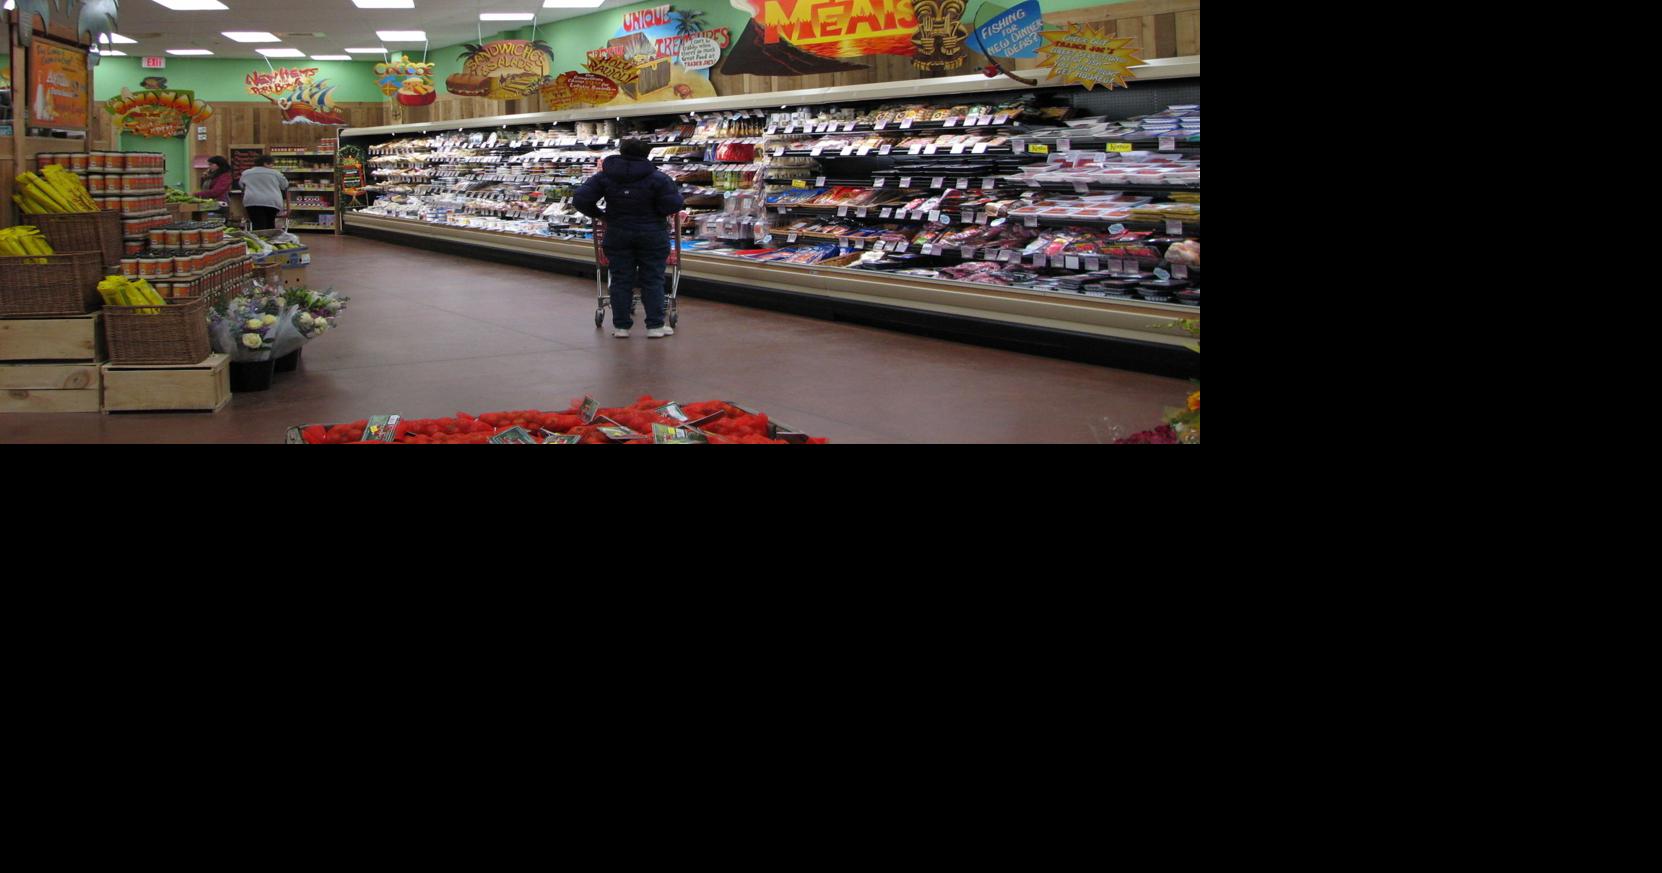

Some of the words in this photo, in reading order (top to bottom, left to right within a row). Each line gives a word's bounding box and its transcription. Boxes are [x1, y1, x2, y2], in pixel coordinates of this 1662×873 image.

[623, 4, 672, 32] UNIQUE
[981, 8, 1026, 39] FISHING
[1002, 25, 1019, 37] FOR
[655, 26, 731, 59] TRERES
[987, 38, 1010, 57] NEW
[1011, 20, 1043, 42] DINNER
[1004, 31, 1041, 58] IDEAS?
[1054, 41, 1087, 50] TRADER
[1088, 45, 1116, 55] JOE'S
[147, 57, 161, 66] EXIT
[466, 42, 547, 71] SANDWICHES
[488, 56, 534, 72] SALADS
